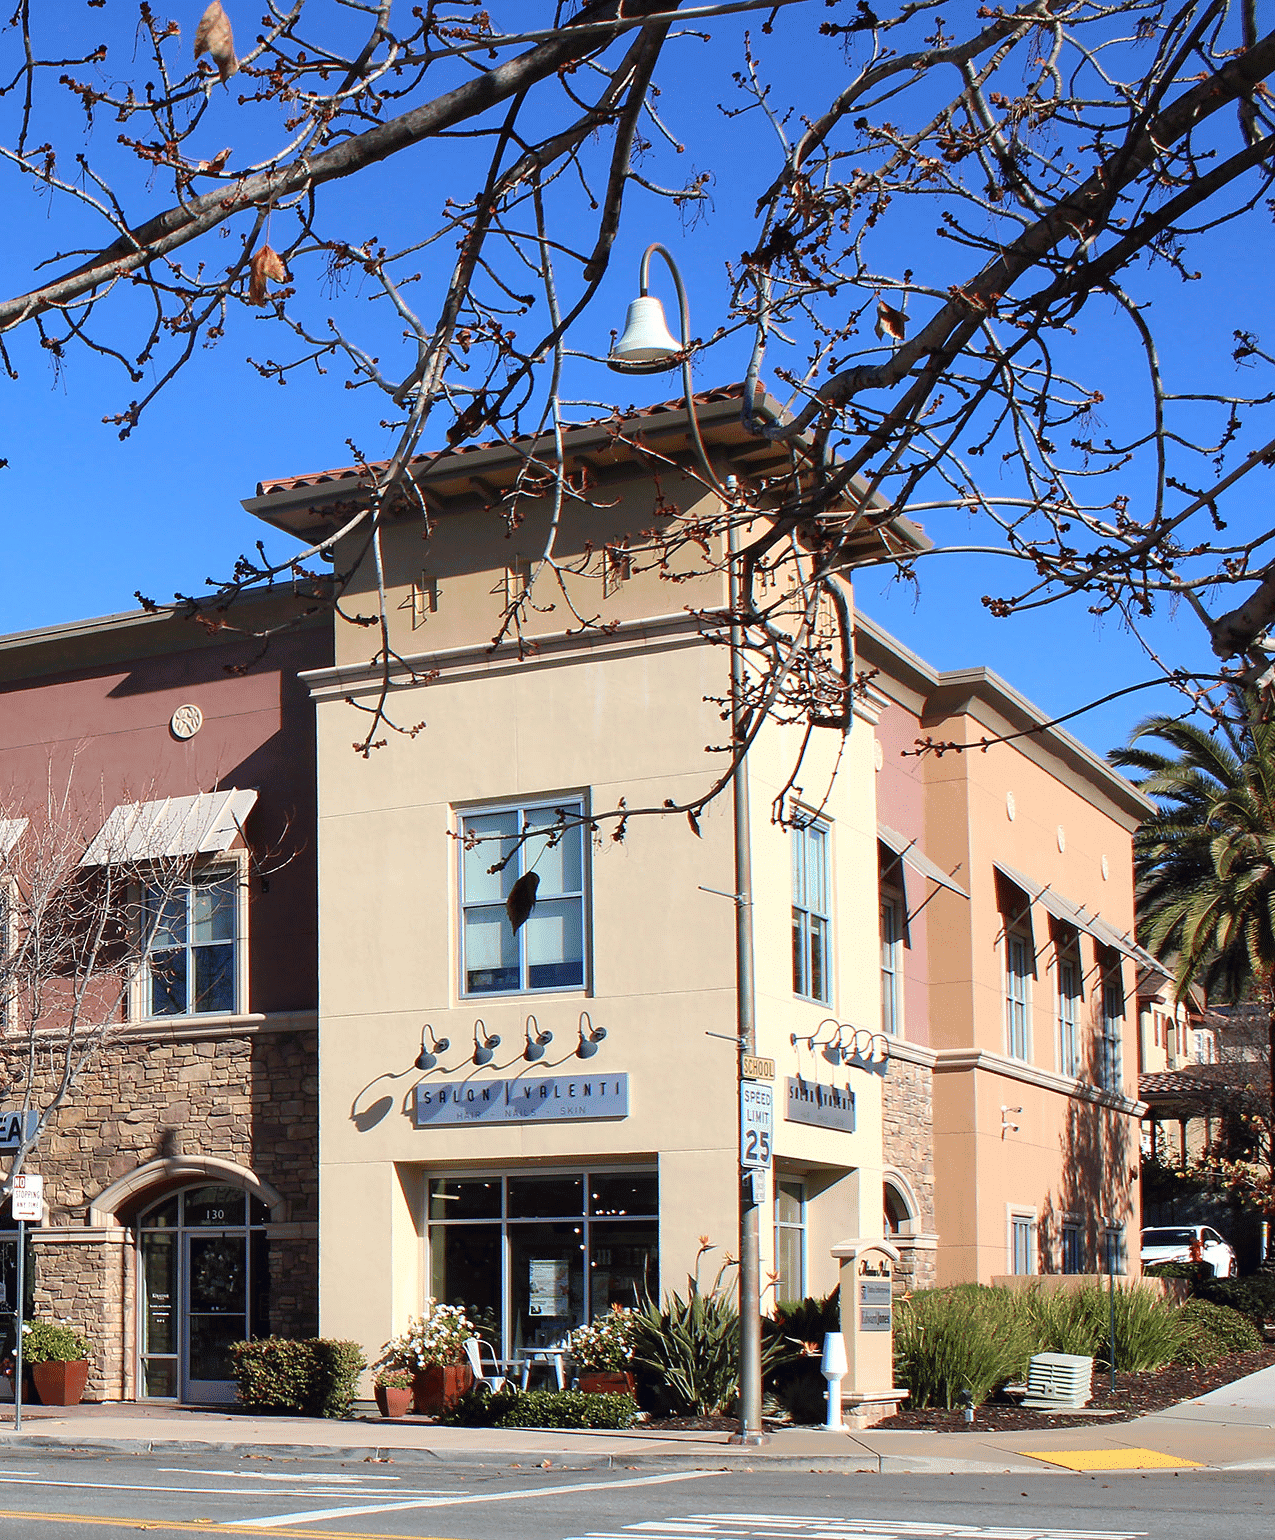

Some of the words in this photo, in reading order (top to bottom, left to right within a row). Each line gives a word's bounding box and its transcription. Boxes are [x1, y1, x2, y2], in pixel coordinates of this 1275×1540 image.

[744, 1058, 774, 1077] SCHOOL
[424, 1088, 490, 1104] SALON
[524, 1082, 620, 1099] VALENTI
[744, 1090, 771, 1105] SPEED
[456, 1111, 481, 1120] HAIR
[504, 1107, 536, 1117] NAILS
[560, 1106, 586, 1115] SKIN
[746, 1109, 770, 1123] LIMIT
[745, 1130, 770, 1162] 25
[14, 1176, 25, 1188] NO
[15, 1190, 40, 1199] STOPPING
[206, 1209, 225, 1220] 130
